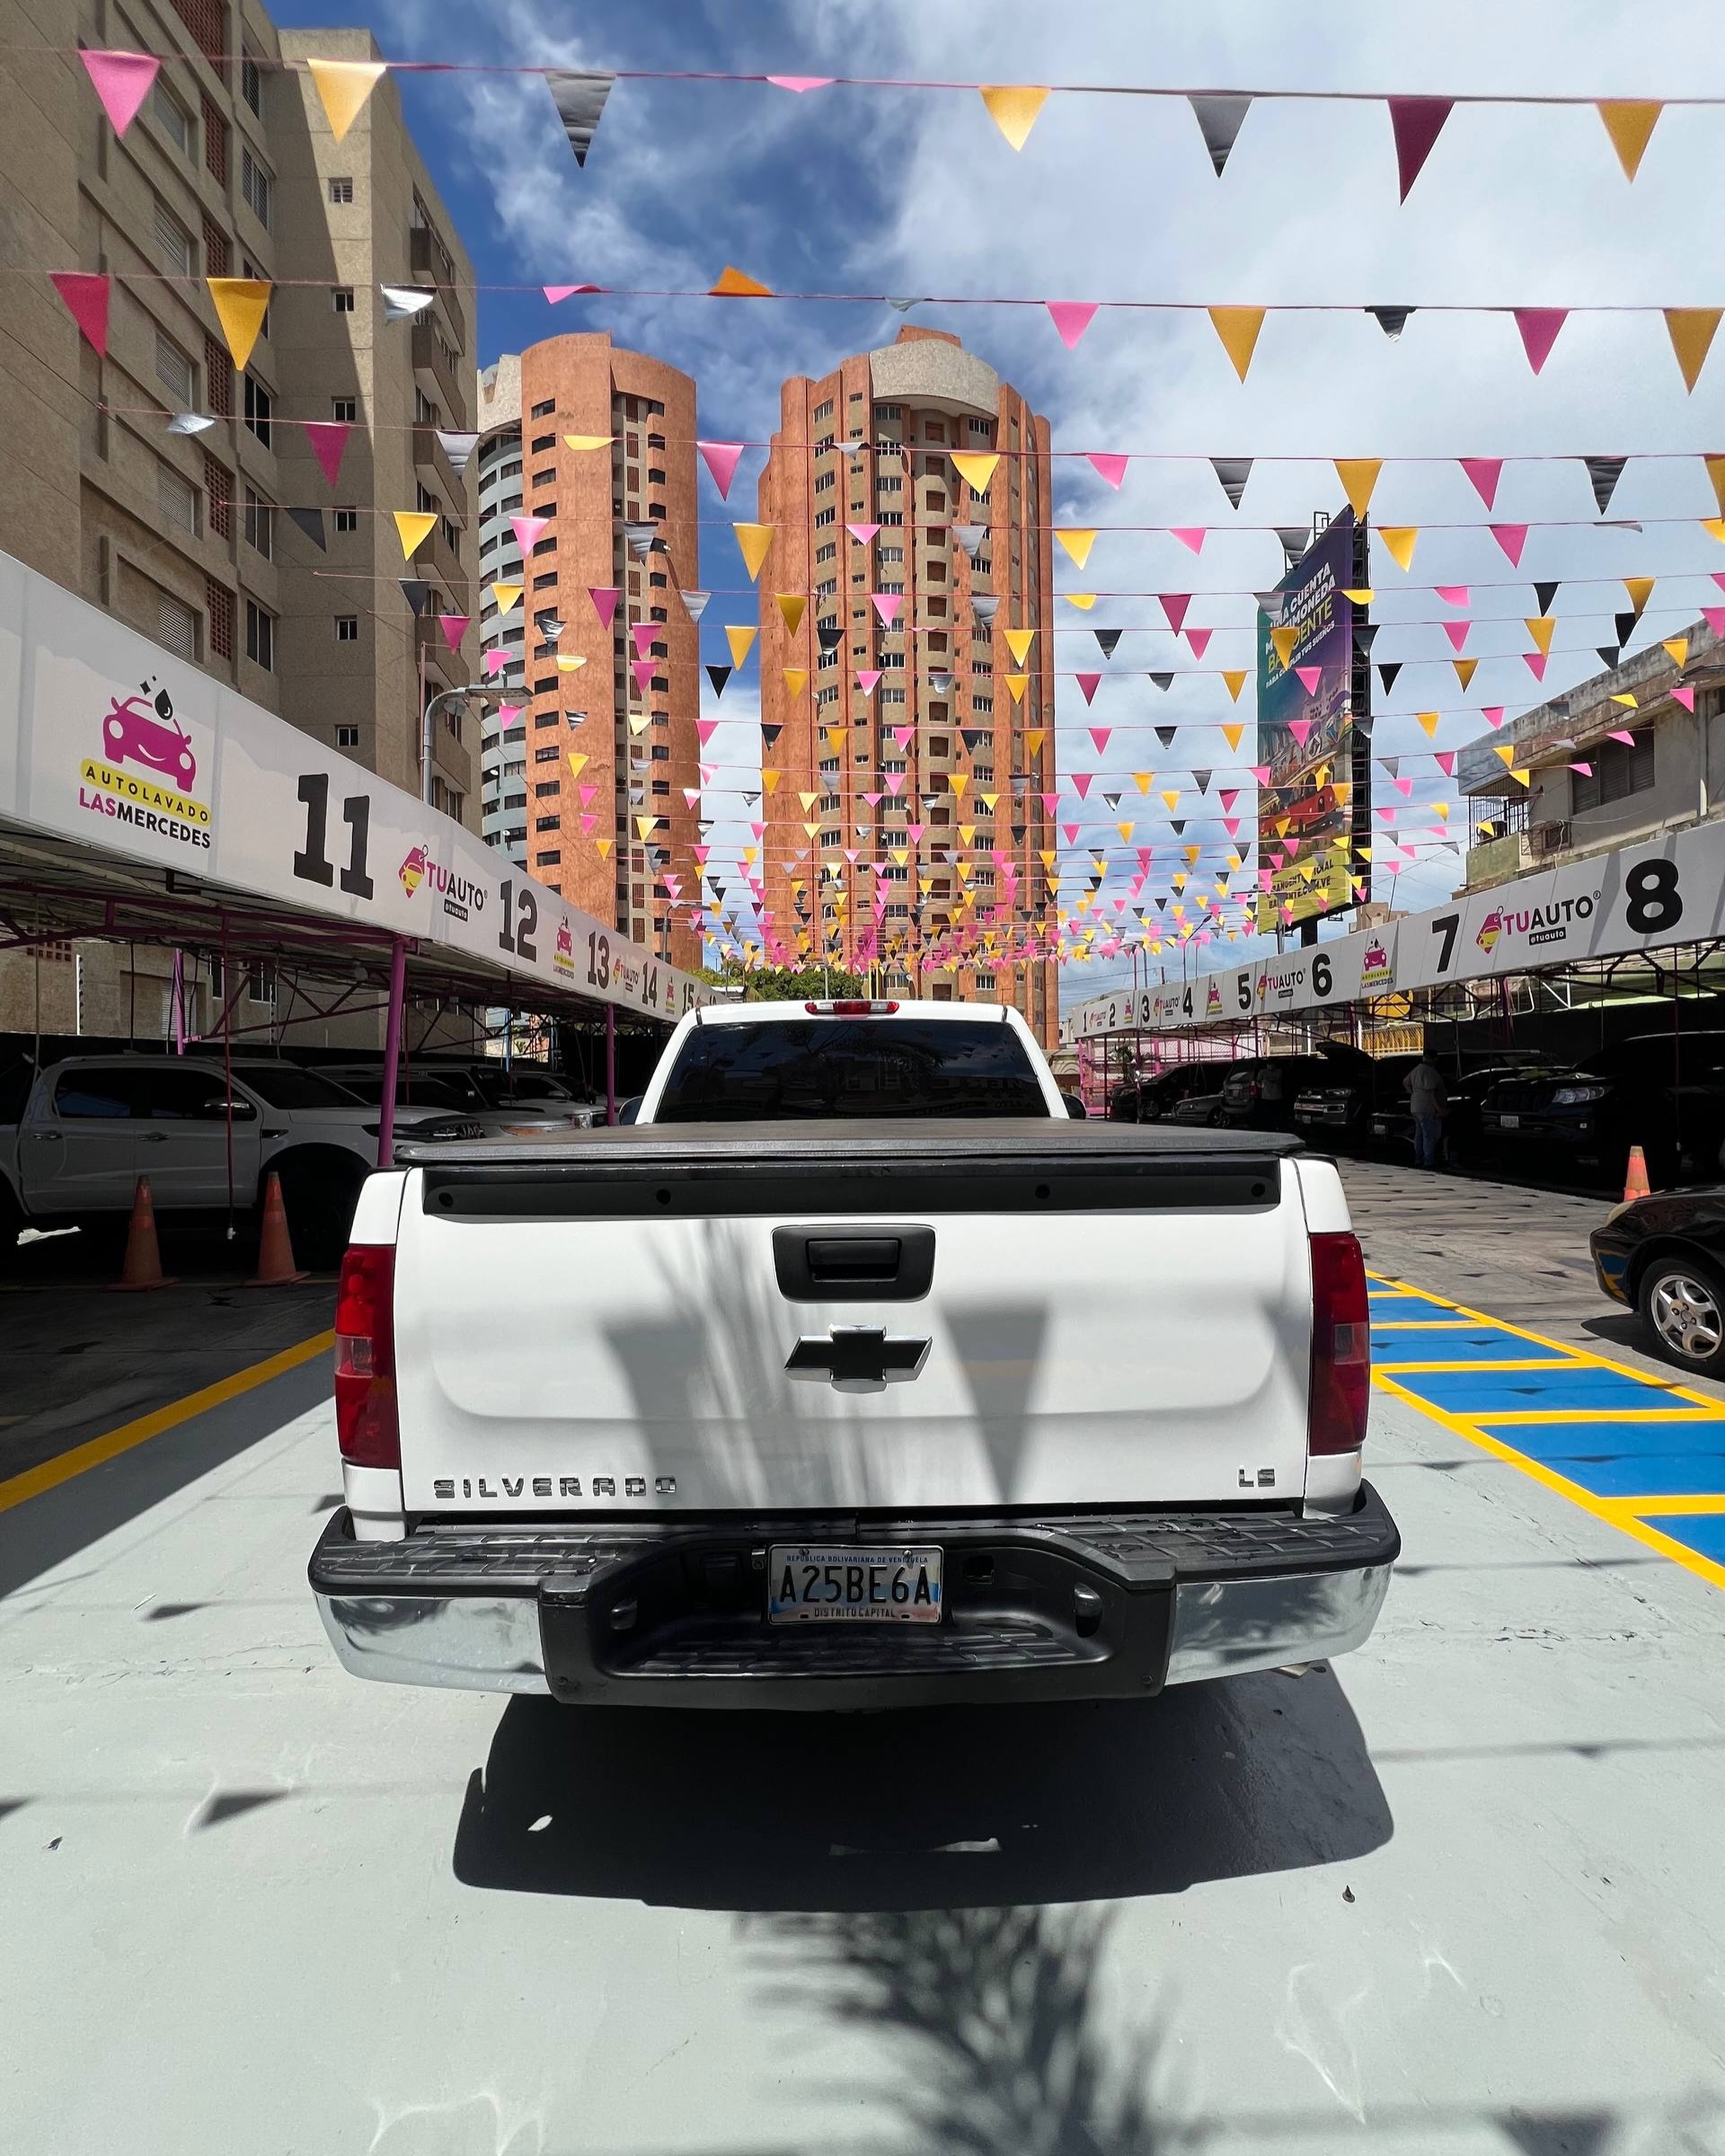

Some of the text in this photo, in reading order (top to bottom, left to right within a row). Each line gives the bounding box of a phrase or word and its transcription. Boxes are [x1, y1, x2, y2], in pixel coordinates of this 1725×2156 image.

[1290, 561, 1331, 613] CUENTA
[85, 765, 208, 822] AUTOLAVADO
[79, 788, 211, 849] LASMERCEDES
[294, 773, 374, 900] 11
[1625, 858, 1683, 934] 8
[499, 879, 538, 962] 12
[1530, 930, 1564, 944] @tuauto
[588, 932, 610, 989] 13
[1432, 914, 1460, 973] 7
[642, 960, 658, 1008] 14
[1238, 973, 1252, 1010] 5
[1312, 953, 1332, 997] 6
[683, 982, 694, 1014] 15
[1110, 1003, 1116, 1027] 2
[1142, 994, 1150, 1022] 3
[1183, 987, 1193, 1018] 4
[1084, 1011, 1087, 1032] 1
[433, 1474, 677, 1498] SILVERADO
[827, 1555, 875, 1563] BOLIVARIANA
[780, 1564, 931, 1605] A25BE6A
[814, 1606, 896, 1618] DISTRITO CAPITAL
